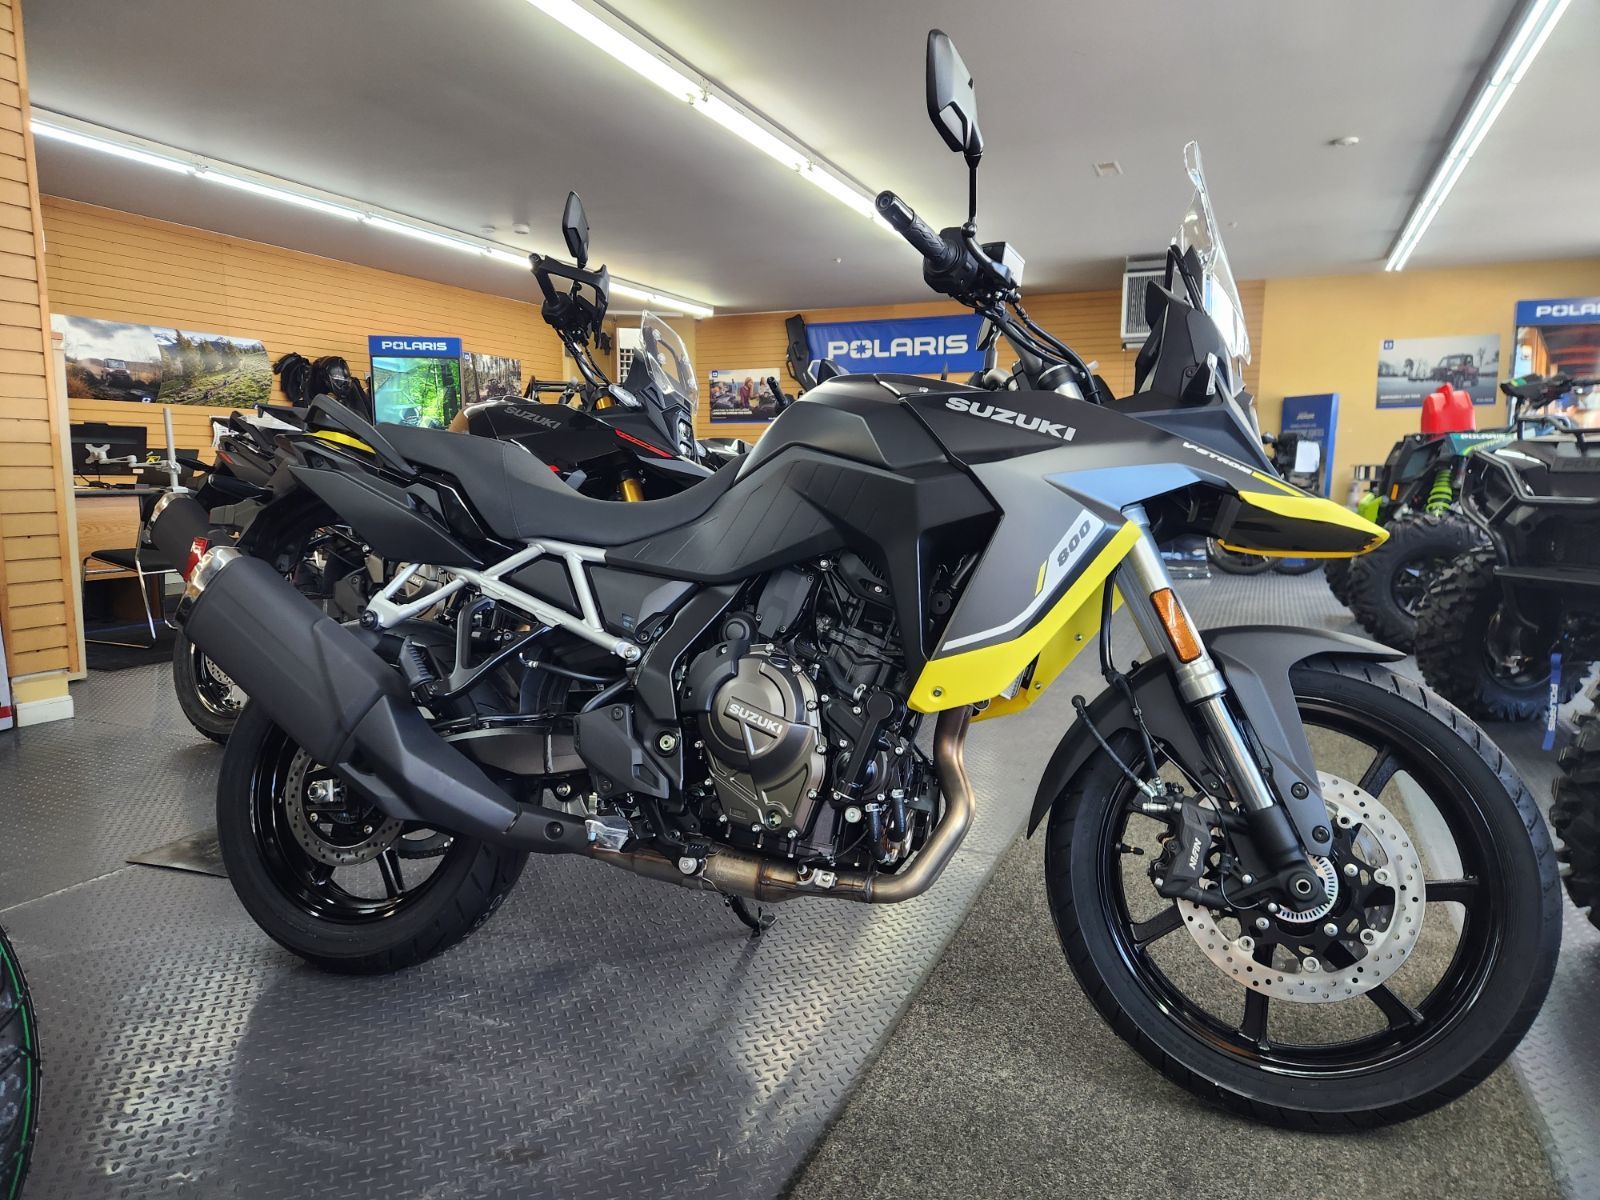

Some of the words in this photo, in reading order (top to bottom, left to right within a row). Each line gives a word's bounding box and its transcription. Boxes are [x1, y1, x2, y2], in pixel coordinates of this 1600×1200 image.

[1535, 303, 1600, 318] POLA
[381, 341, 447, 351] POLARIS
[828, 334, 968, 360] POLARIS
[503, 406, 561, 430] SUZUKI
[945, 397, 1077, 441] SUZUKI
[1182, 441, 1253, 475] V-STROM
[1057, 519, 1091, 568] 800
[729, 703, 783, 734] SUZUKI
[1547, 683, 1559, 732] POLARIS
